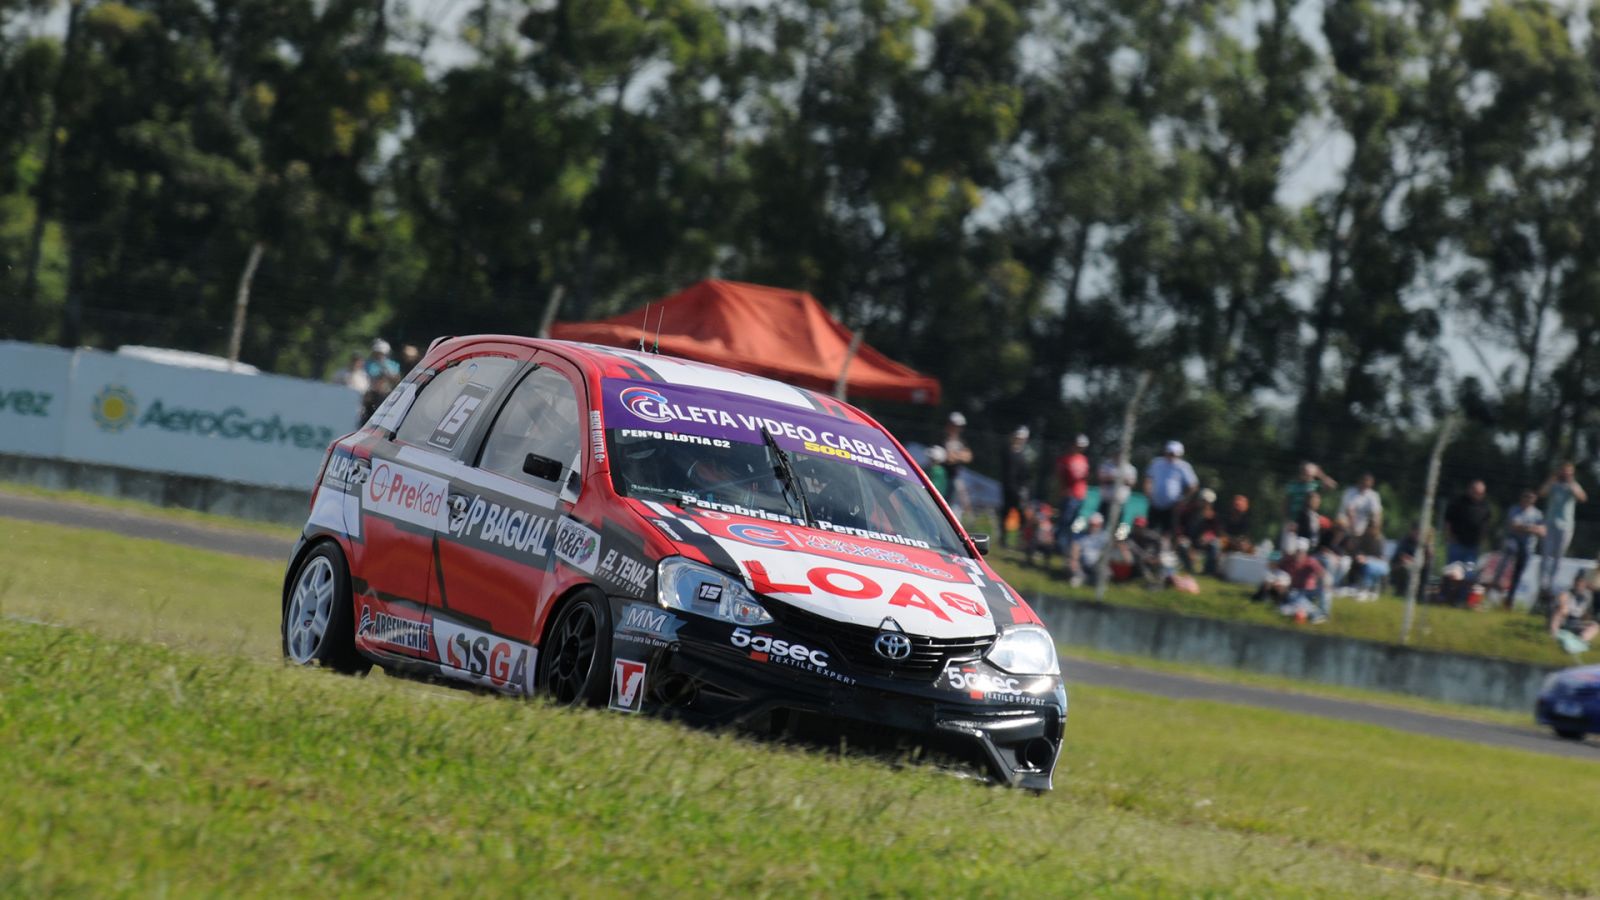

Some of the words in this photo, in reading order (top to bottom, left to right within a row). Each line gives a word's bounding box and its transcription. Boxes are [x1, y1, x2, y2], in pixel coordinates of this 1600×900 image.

[437, 394, 482, 435] 15
[638, 400, 739, 429] CALETA
[736, 413, 817, 443] VIDEO
[821, 431, 899, 466] CABLE
[388, 473, 446, 516] PreKad
[480, 504, 554, 557] BAGUAL
[817, 519, 931, 549] Pergamino
[600, 549, 619, 571] EL
[615, 555, 655, 589] TENAZ
[699, 584, 722, 600] 15
[625, 606, 668, 633] MM
[730, 626, 829, 667] 5asec
[769, 653, 813, 671] TEXTILE
[816, 667, 857, 686] EXPERT
[983, 691, 1014, 703] TEXTILE
[1014, 696, 1046, 706] EXPERT
